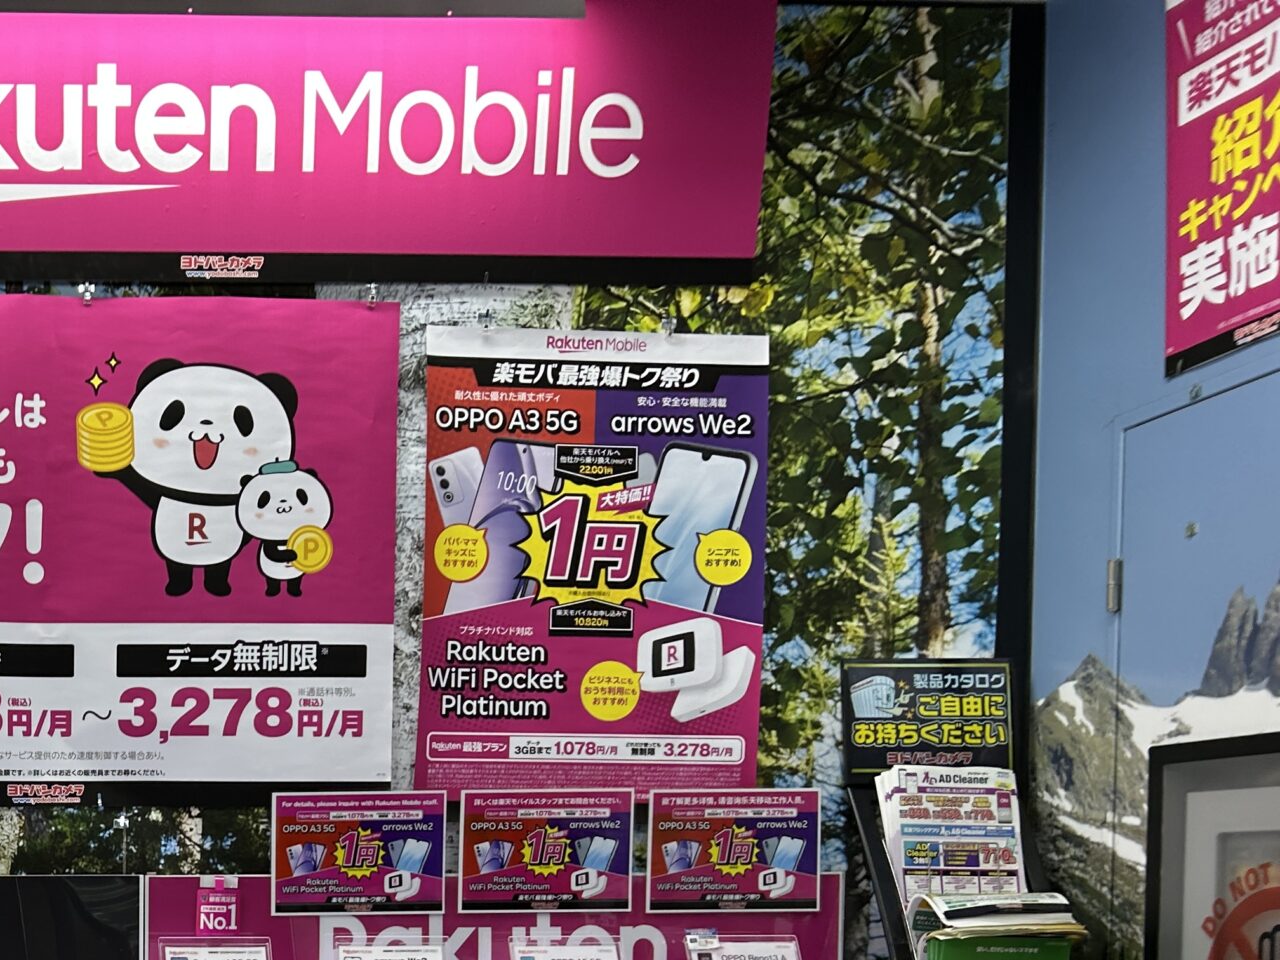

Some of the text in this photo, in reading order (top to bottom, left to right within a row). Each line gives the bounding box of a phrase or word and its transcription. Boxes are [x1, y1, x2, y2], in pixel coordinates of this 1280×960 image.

[303, 65, 644, 178] Mobile
[179, 255, 266, 269] ヨドバシカメラ
[1179, 211, 1279, 321] 実施
[546, 336, 647, 352] Rakuten Mobile
[435, 408, 579, 433] OPPO A3 5G
[611, 415, 752, 437] arrows We2
[497, 470, 537, 494] 10:00
[542, 495, 641, 582] 1円
[445, 547, 477, 558] キッズに
[706, 547, 741, 558] シニアに
[459, 625, 534, 636] プラチナバンド対応
[447, 640, 546, 663] Rakuten
[428, 668, 565, 690] WiFi Pocket
[913, 673, 1005, 689] 製品カタログ
[584, 686, 637, 697] おうち利用にも
[441, 694, 548, 718] Platinum
[917, 694, 1006, 718] ご自由に
[853, 721, 1008, 746] お持ちください
[463, 741, 507, 753] 最強プラン
[515, 745, 552, 757] 3GBまで
[886, 751, 973, 765] ヨドバシカメラ
[938, 773, 989, 785] AD Cleaner
[7, 784, 84, 797] ヨドバシカメラ
[282, 824, 308, 833] OPPO
[309, 824, 322, 833] A3
[382, 822, 434, 831] arrows We2
[470, 822, 496, 830] OPPO
[498, 822, 510, 830] A3
[570, 820, 621, 829] arrows We2
[658, 822, 684, 830] OPPO
[684, 822, 697, 830] A3
[756, 820, 808, 829] arrows We2
[339, 831, 378, 867] 1円
[526, 828, 566, 864] 1円
[714, 828, 753, 864] 1円
[1200, 861, 1271, 939] DO NOT
[200, 904, 238, 930] No.1
